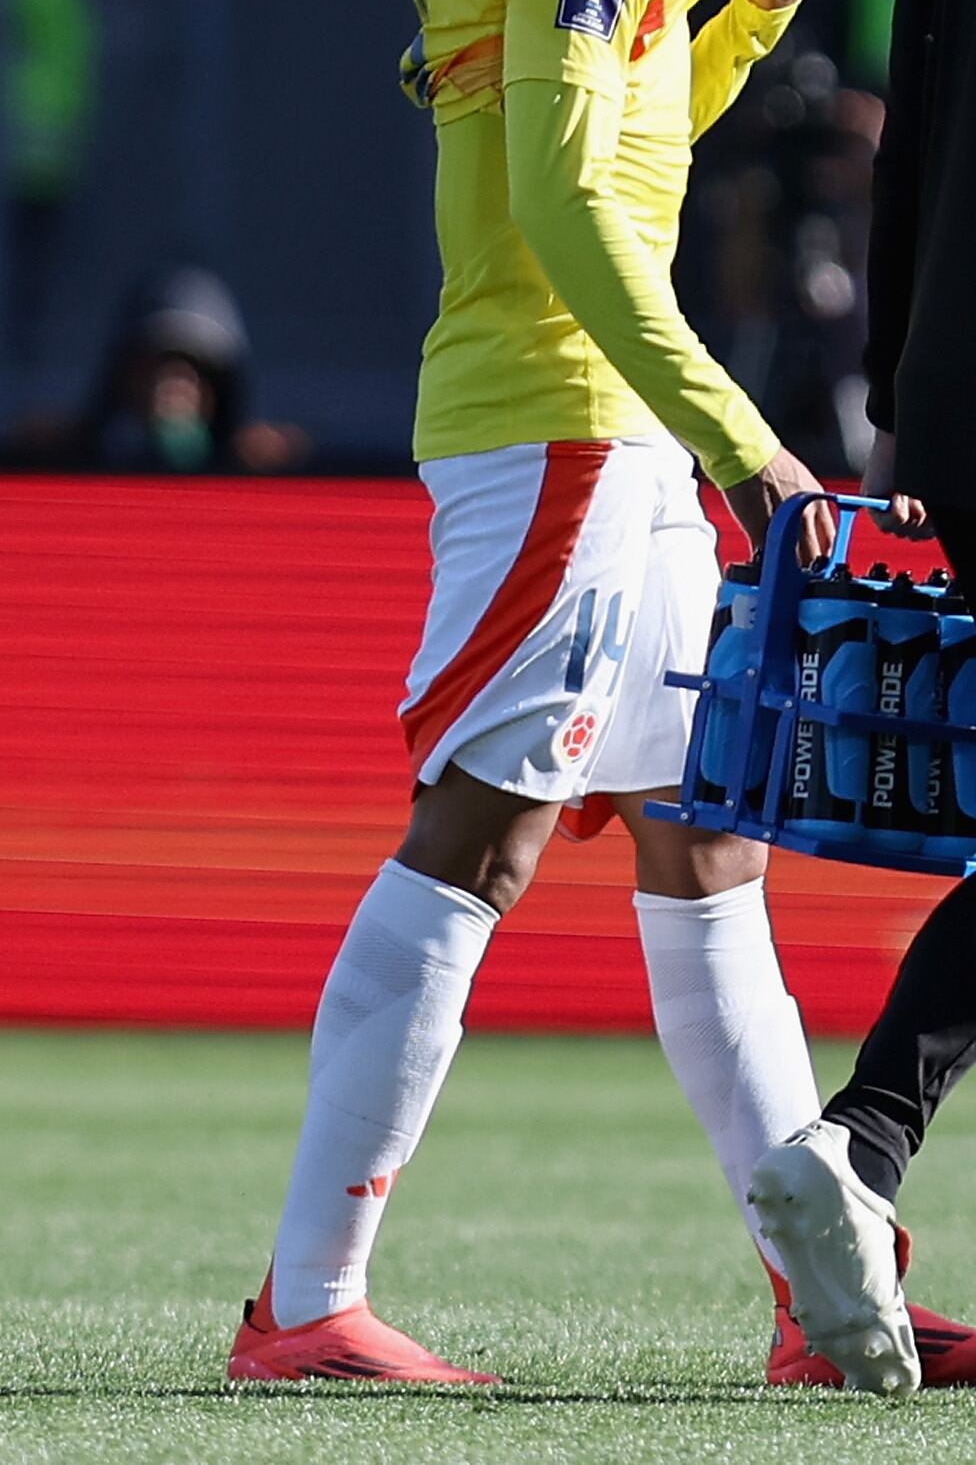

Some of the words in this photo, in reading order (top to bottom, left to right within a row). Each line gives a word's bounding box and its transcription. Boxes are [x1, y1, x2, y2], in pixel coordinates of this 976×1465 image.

[564, 588, 635, 696] 14
[792, 652, 820, 800] POWEADE
[872, 661, 904, 809] POWEADE
